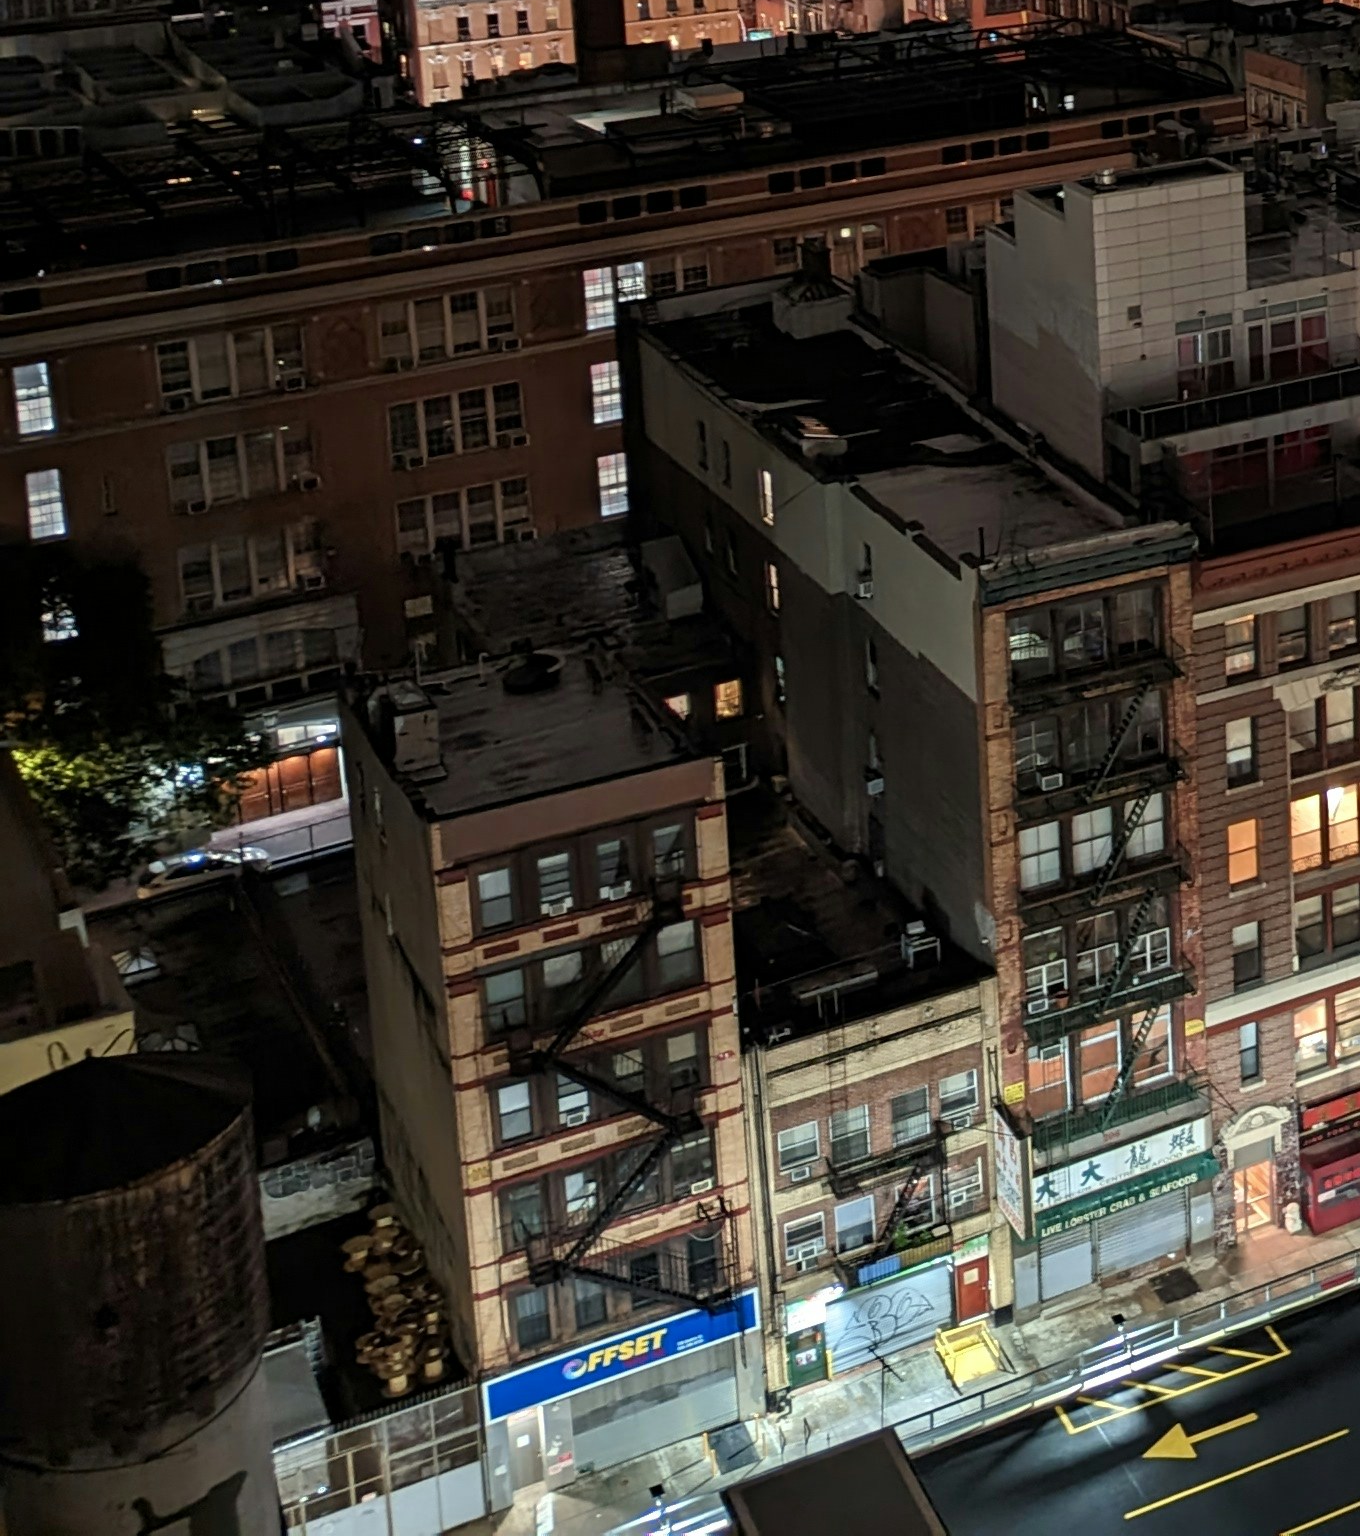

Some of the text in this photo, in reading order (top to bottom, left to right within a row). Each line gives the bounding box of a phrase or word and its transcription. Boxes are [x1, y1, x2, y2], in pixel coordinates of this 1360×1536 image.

[1041, 1224, 1062, 1238] LIVE
[1065, 1206, 1107, 1229] LOBSTER
[1110, 1197, 1136, 1212] CRAB
[1149, 1173, 1198, 1198] SEAFOODS
[562, 1328, 668, 1380] OFFSET
